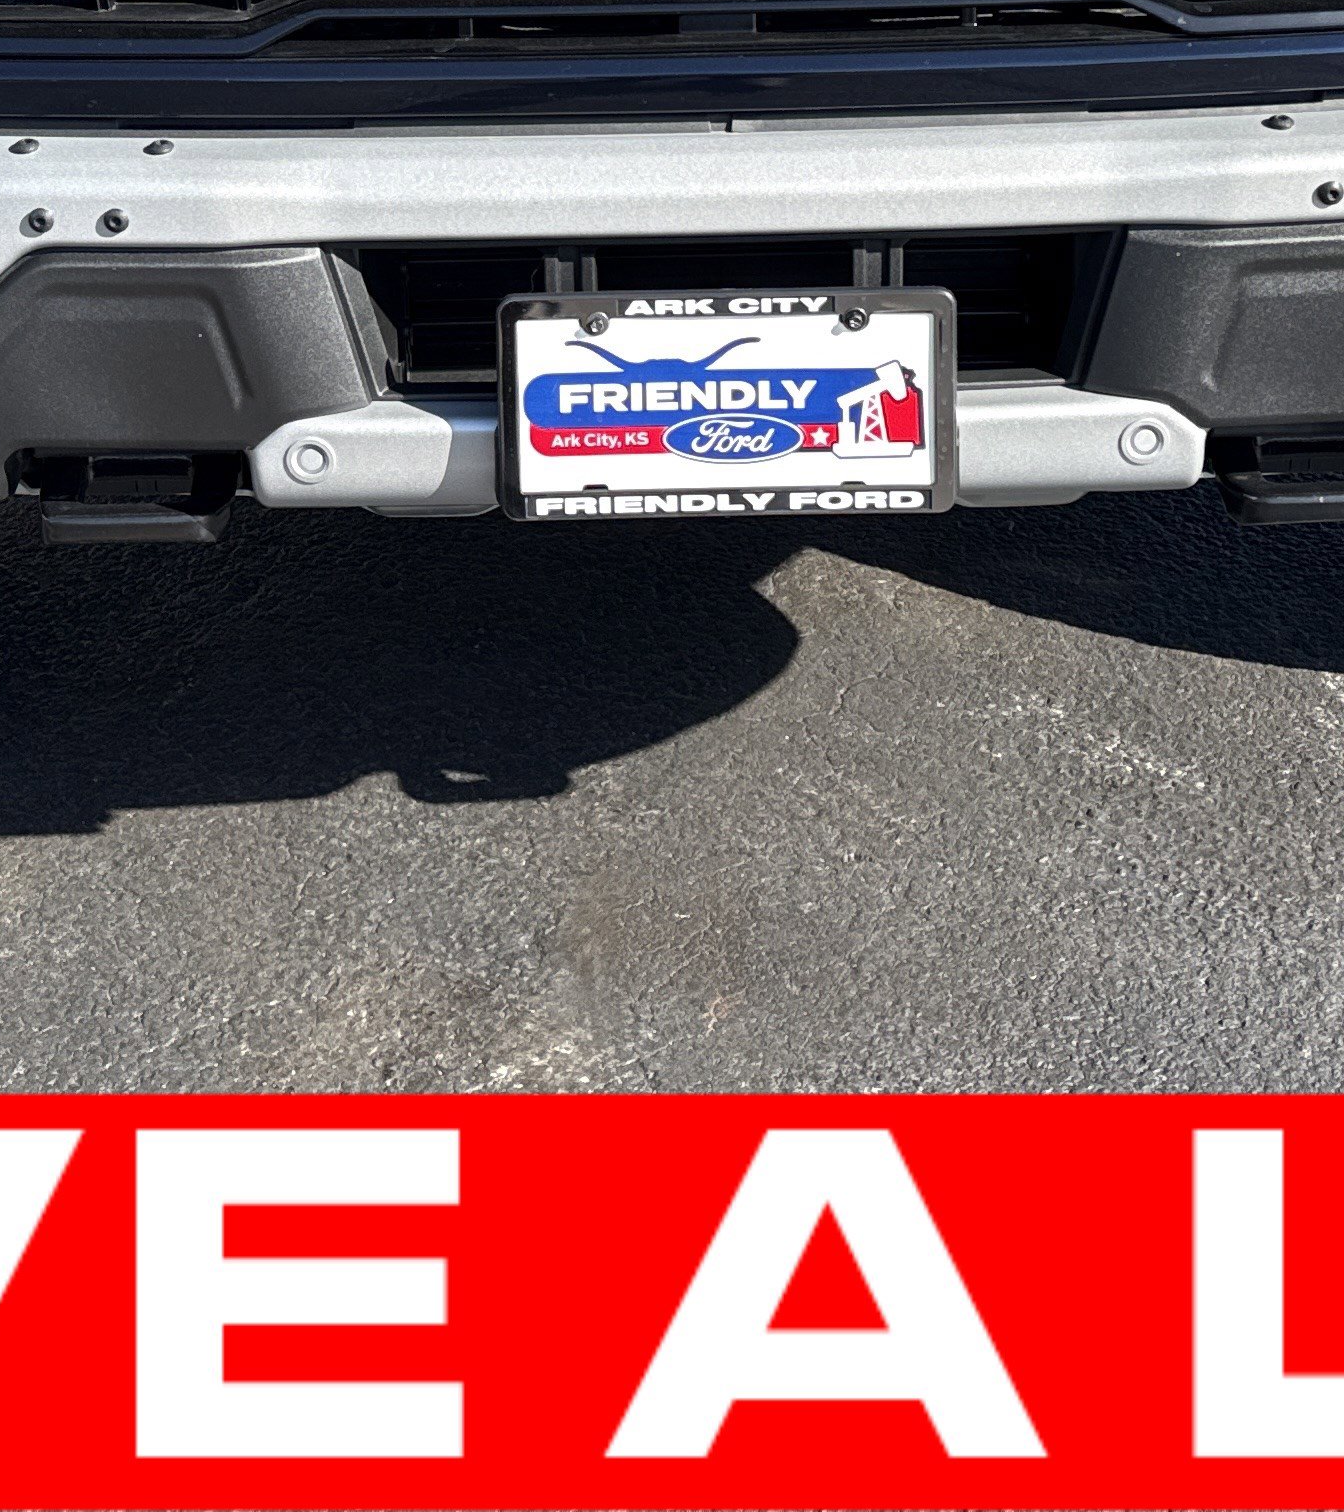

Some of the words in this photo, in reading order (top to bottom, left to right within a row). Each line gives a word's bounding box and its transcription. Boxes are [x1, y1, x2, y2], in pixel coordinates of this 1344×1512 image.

[623, 297, 716, 317] ARK
[727, 295, 828, 314] CITY
[558, 379, 818, 414] FRIENDLY
[551, 433, 582, 448] Ark
[583, 432, 622, 450] City,
[624, 432, 650, 447] KS
[690, 419, 776, 455] Ford
[535, 492, 784, 516] FRIENDLY
[788, 489, 925, 511] FORD
